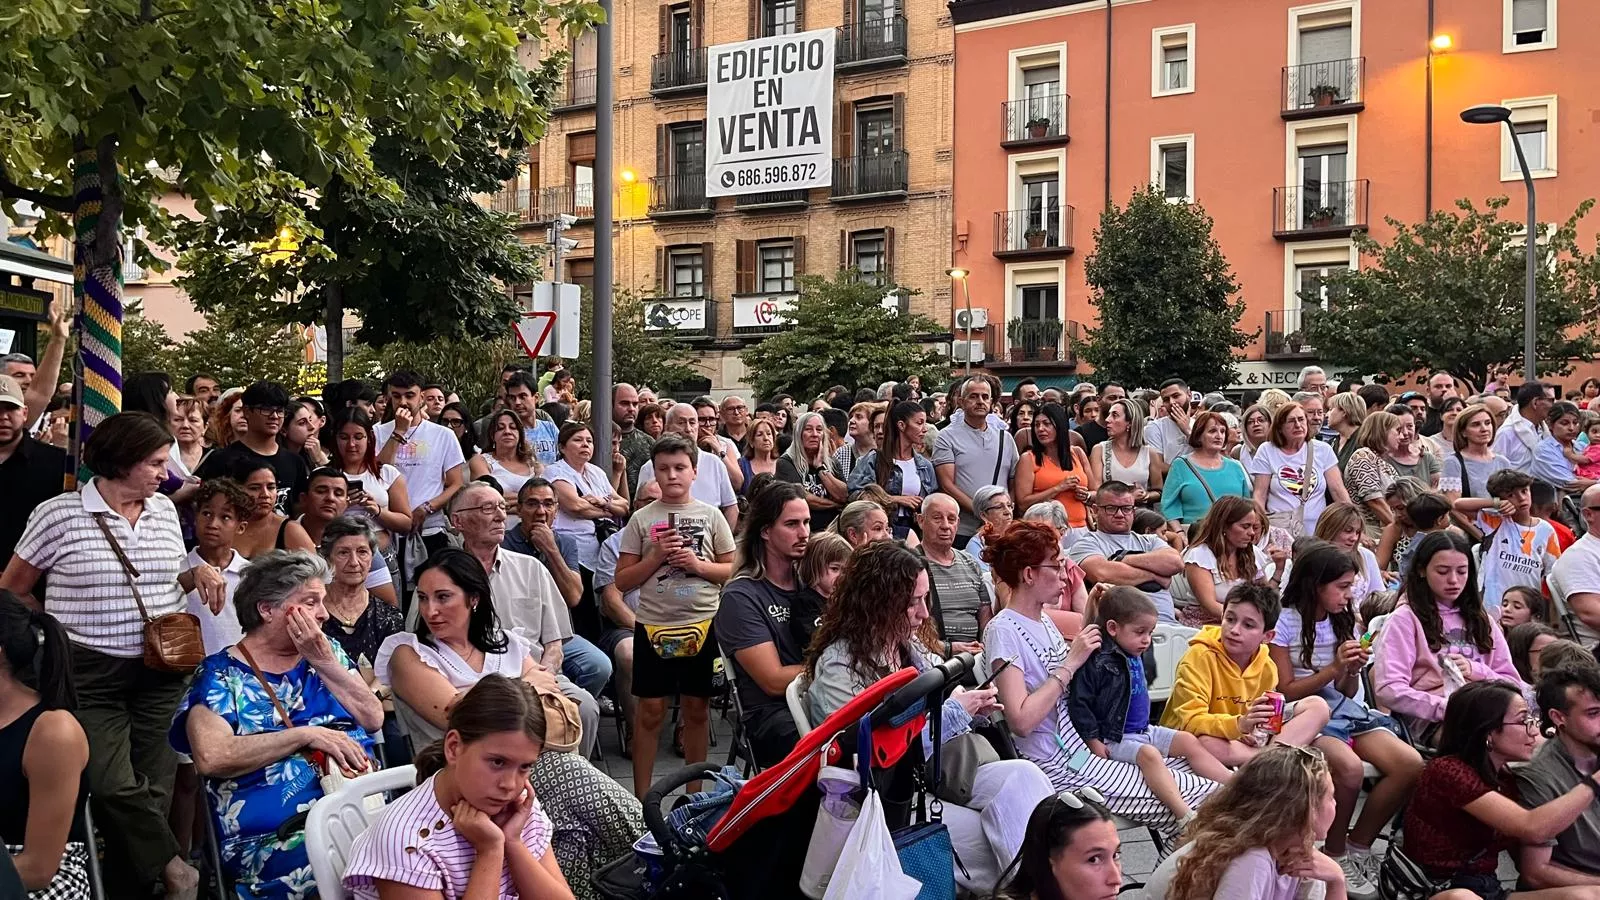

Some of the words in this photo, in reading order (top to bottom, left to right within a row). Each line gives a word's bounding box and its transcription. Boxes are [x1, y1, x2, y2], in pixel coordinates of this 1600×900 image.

[716, 38, 824, 84] EDIFICIO
[753, 77, 783, 108] EN
[718, 105, 821, 155] VENTA
[738, 163, 816, 187] 686.596.872
[672, 308, 701, 321] COPE
[1246, 372, 1258, 385] &
[1500, 551, 1540, 568] Emirates
[1502, 561, 1512, 569] FLY
[1512, 563, 1533, 574] BETTER
